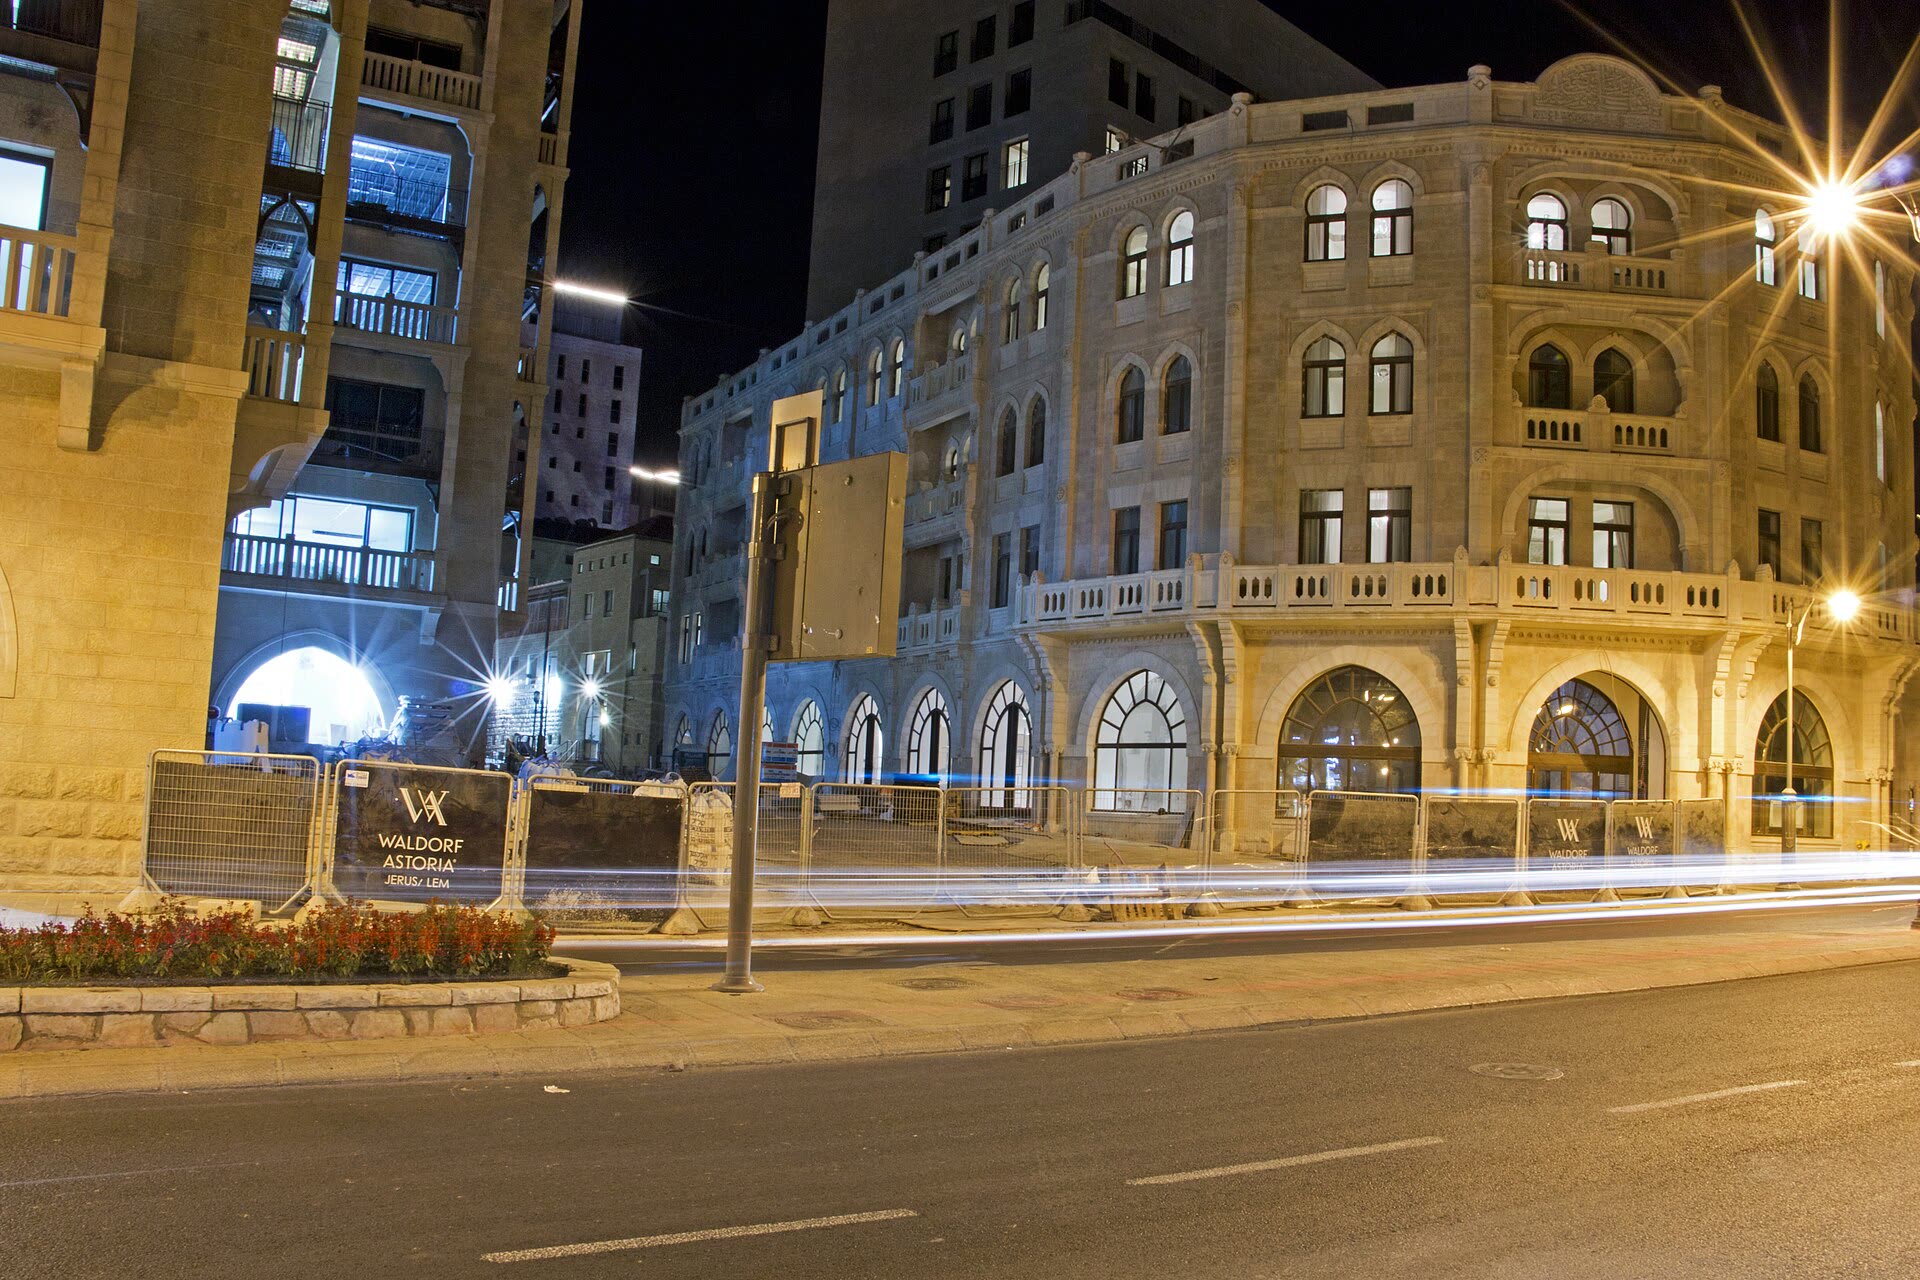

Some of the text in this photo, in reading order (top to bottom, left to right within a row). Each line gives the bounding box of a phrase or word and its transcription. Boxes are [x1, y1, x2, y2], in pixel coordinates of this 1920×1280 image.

[378, 833, 464, 853] WALDORF
[1627, 845, 1659, 856] WALDORF
[1549, 849, 1588, 860] WALDORF
[383, 854, 456, 873] ASTORIA
